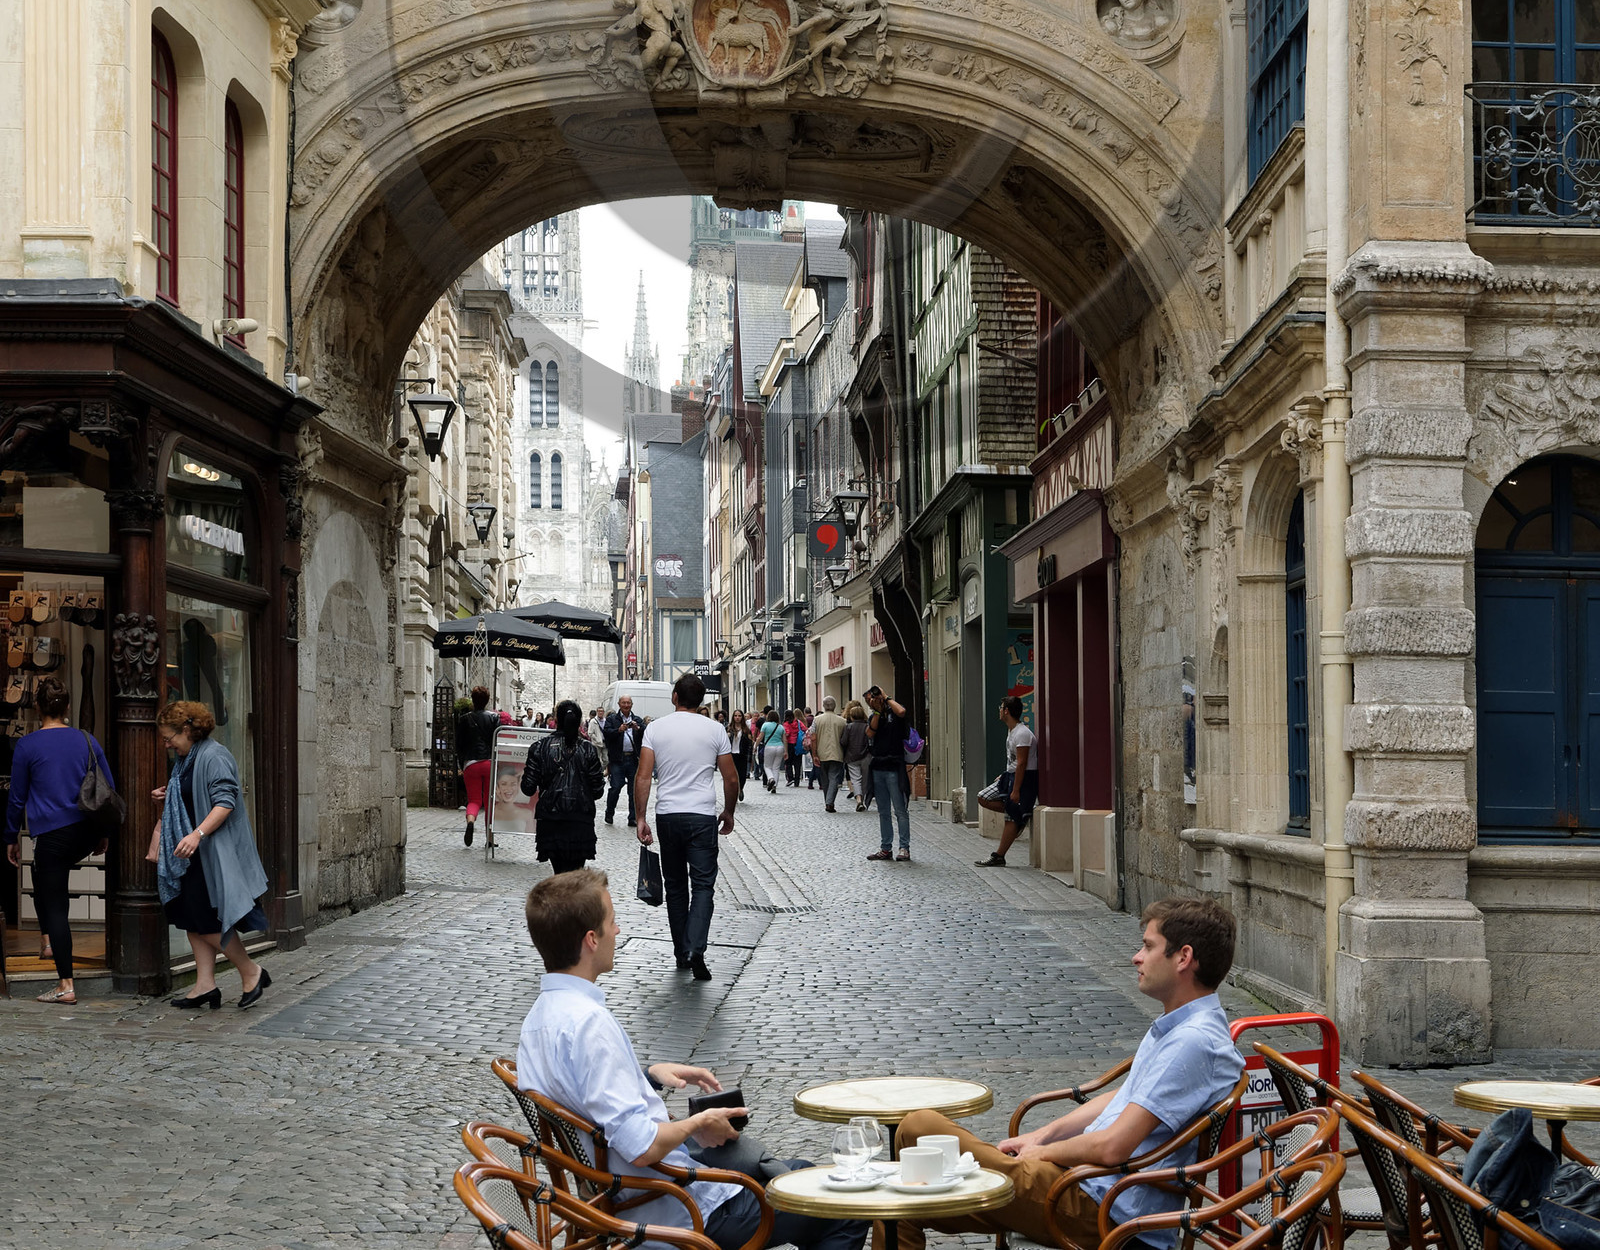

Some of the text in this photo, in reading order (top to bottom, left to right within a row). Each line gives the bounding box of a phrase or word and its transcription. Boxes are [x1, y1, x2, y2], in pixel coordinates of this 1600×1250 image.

[560, 620, 592, 632] Passage
[443, 635, 459, 646] Les
[491, 637, 502, 647] du
[505, 639, 540, 652] Passage
